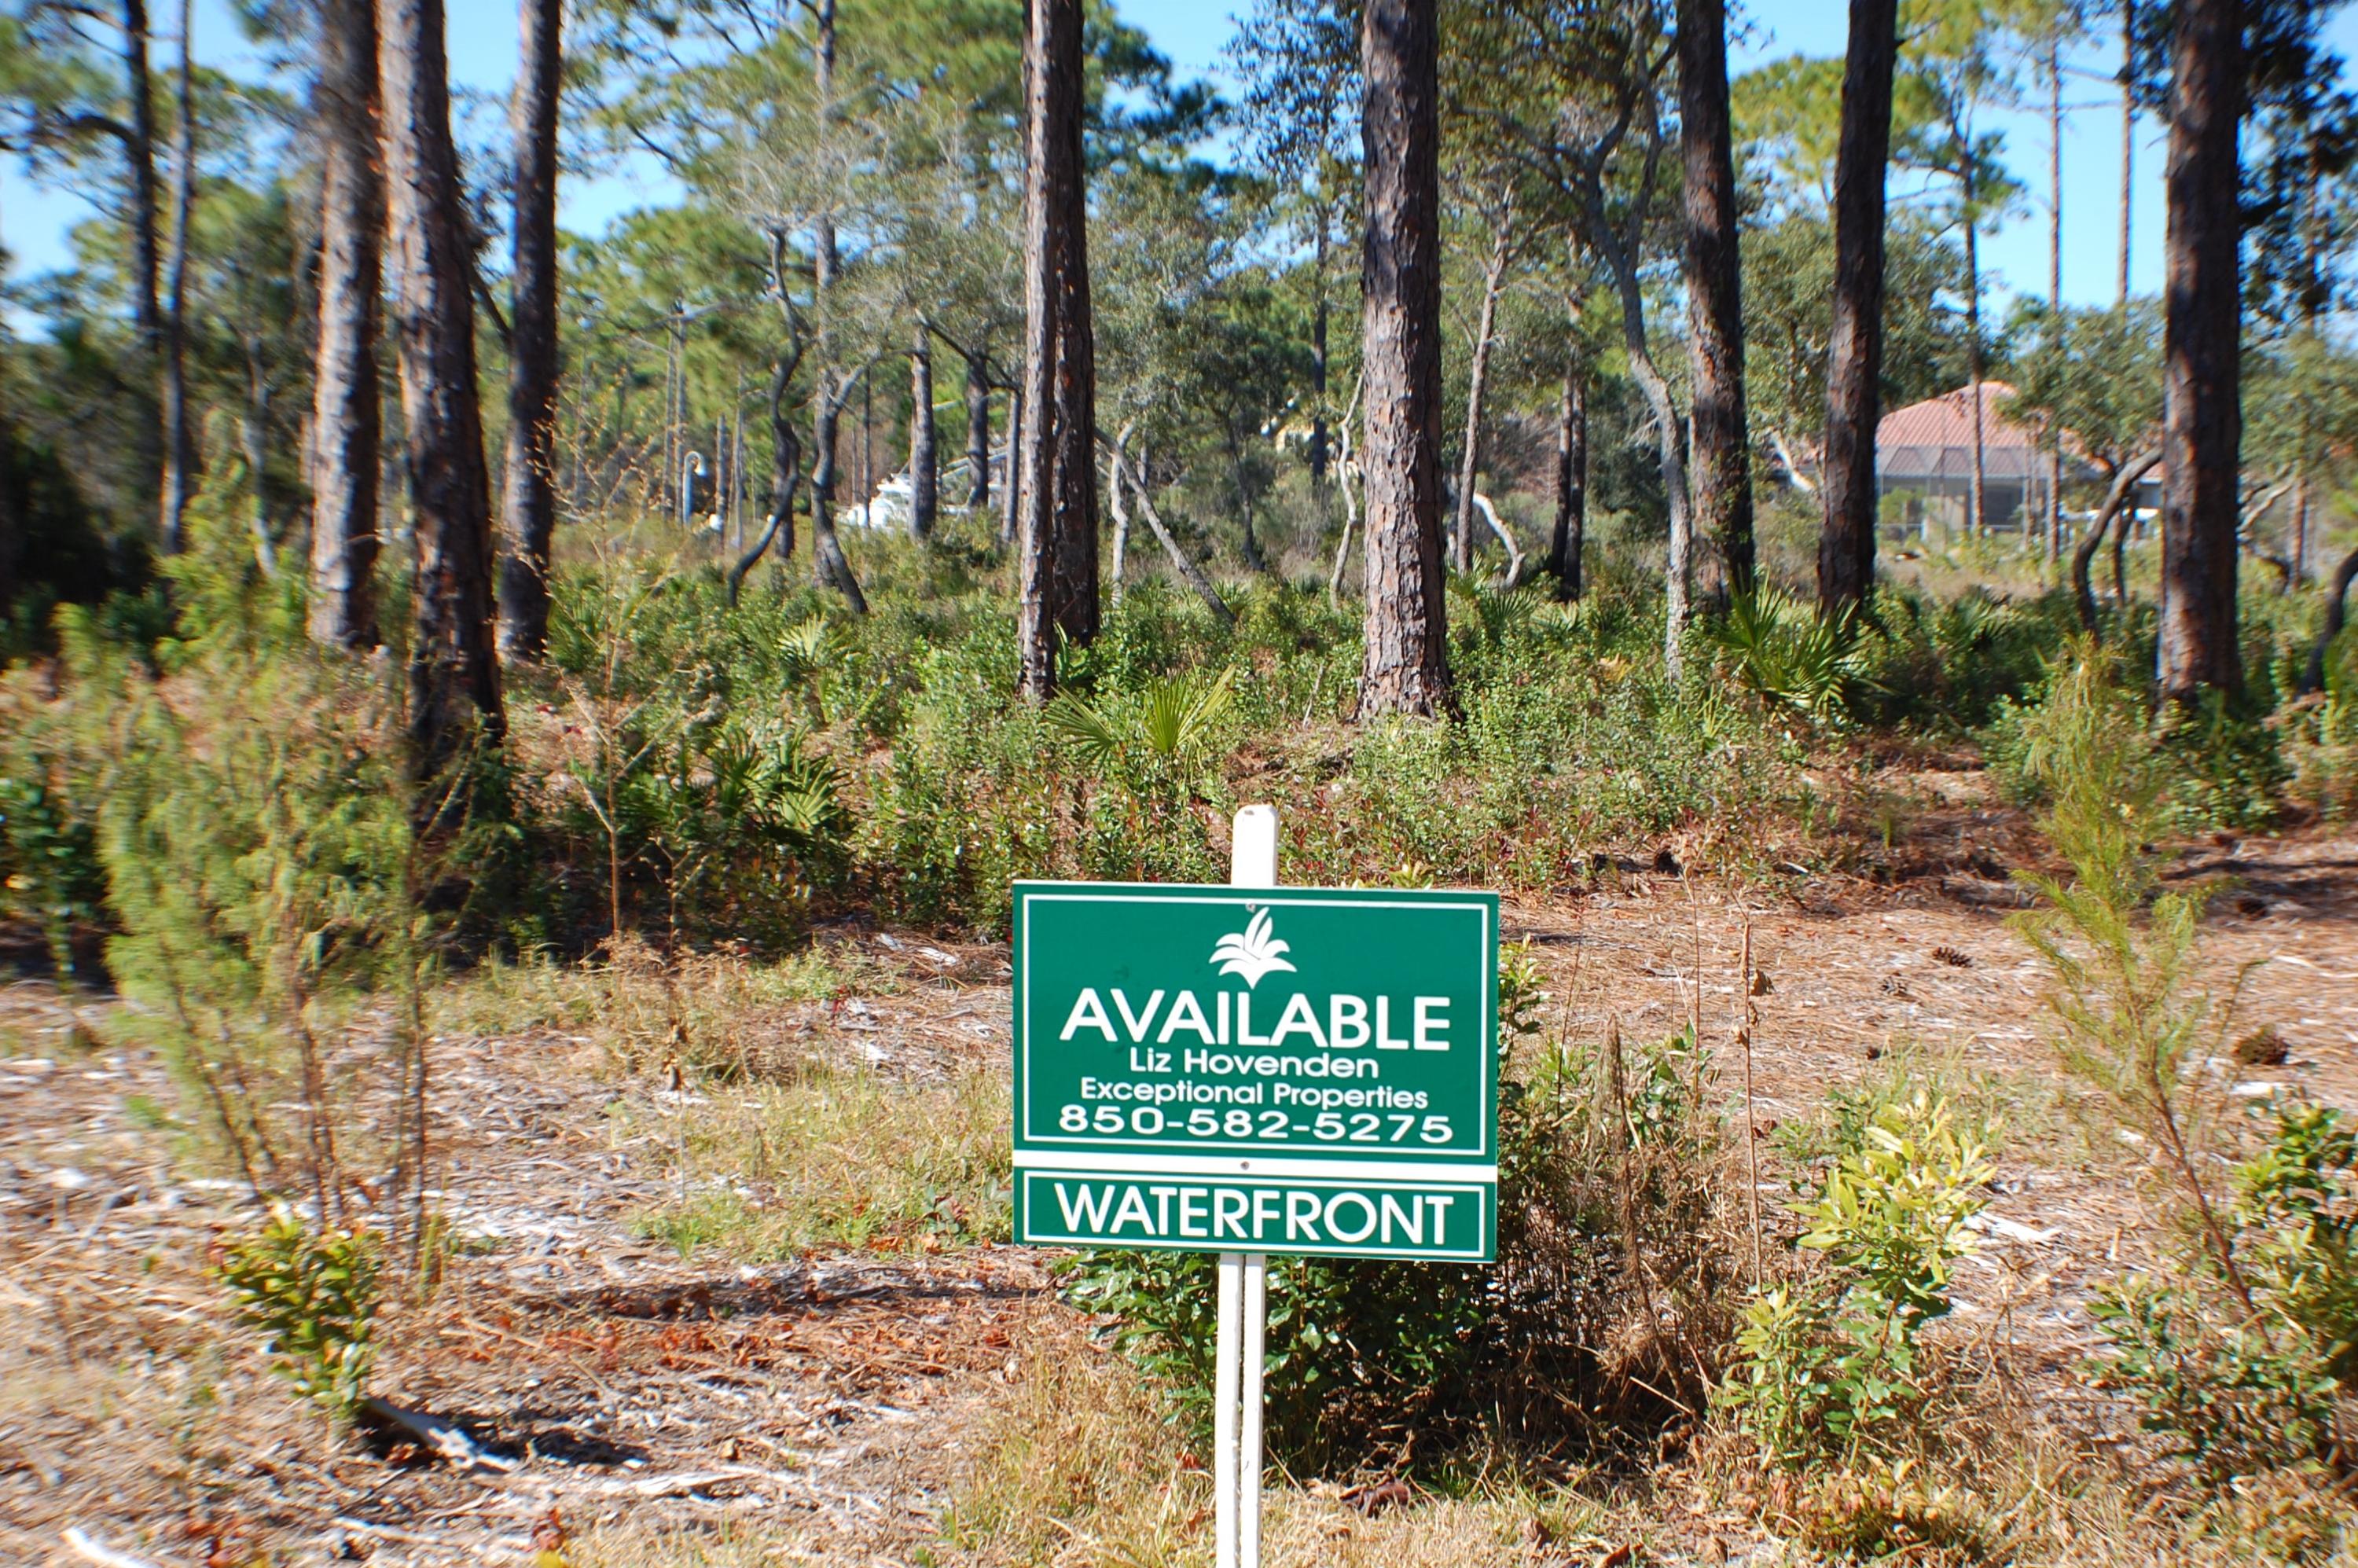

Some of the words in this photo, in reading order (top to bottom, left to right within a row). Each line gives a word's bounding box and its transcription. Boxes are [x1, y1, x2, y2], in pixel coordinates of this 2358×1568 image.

[1059, 987, 1451, 1051] AVAILABLE
[1129, 1048, 1172, 1073] Liz
[1184, 1049, 1379, 1078] Hovenden
[1081, 1078, 1263, 1105] Exceptional
[1273, 1083, 1428, 1110] Properties
[1059, 1105, 1453, 1144] 850-582-5275
[1054, 1183, 1454, 1245] WATERFRONT
